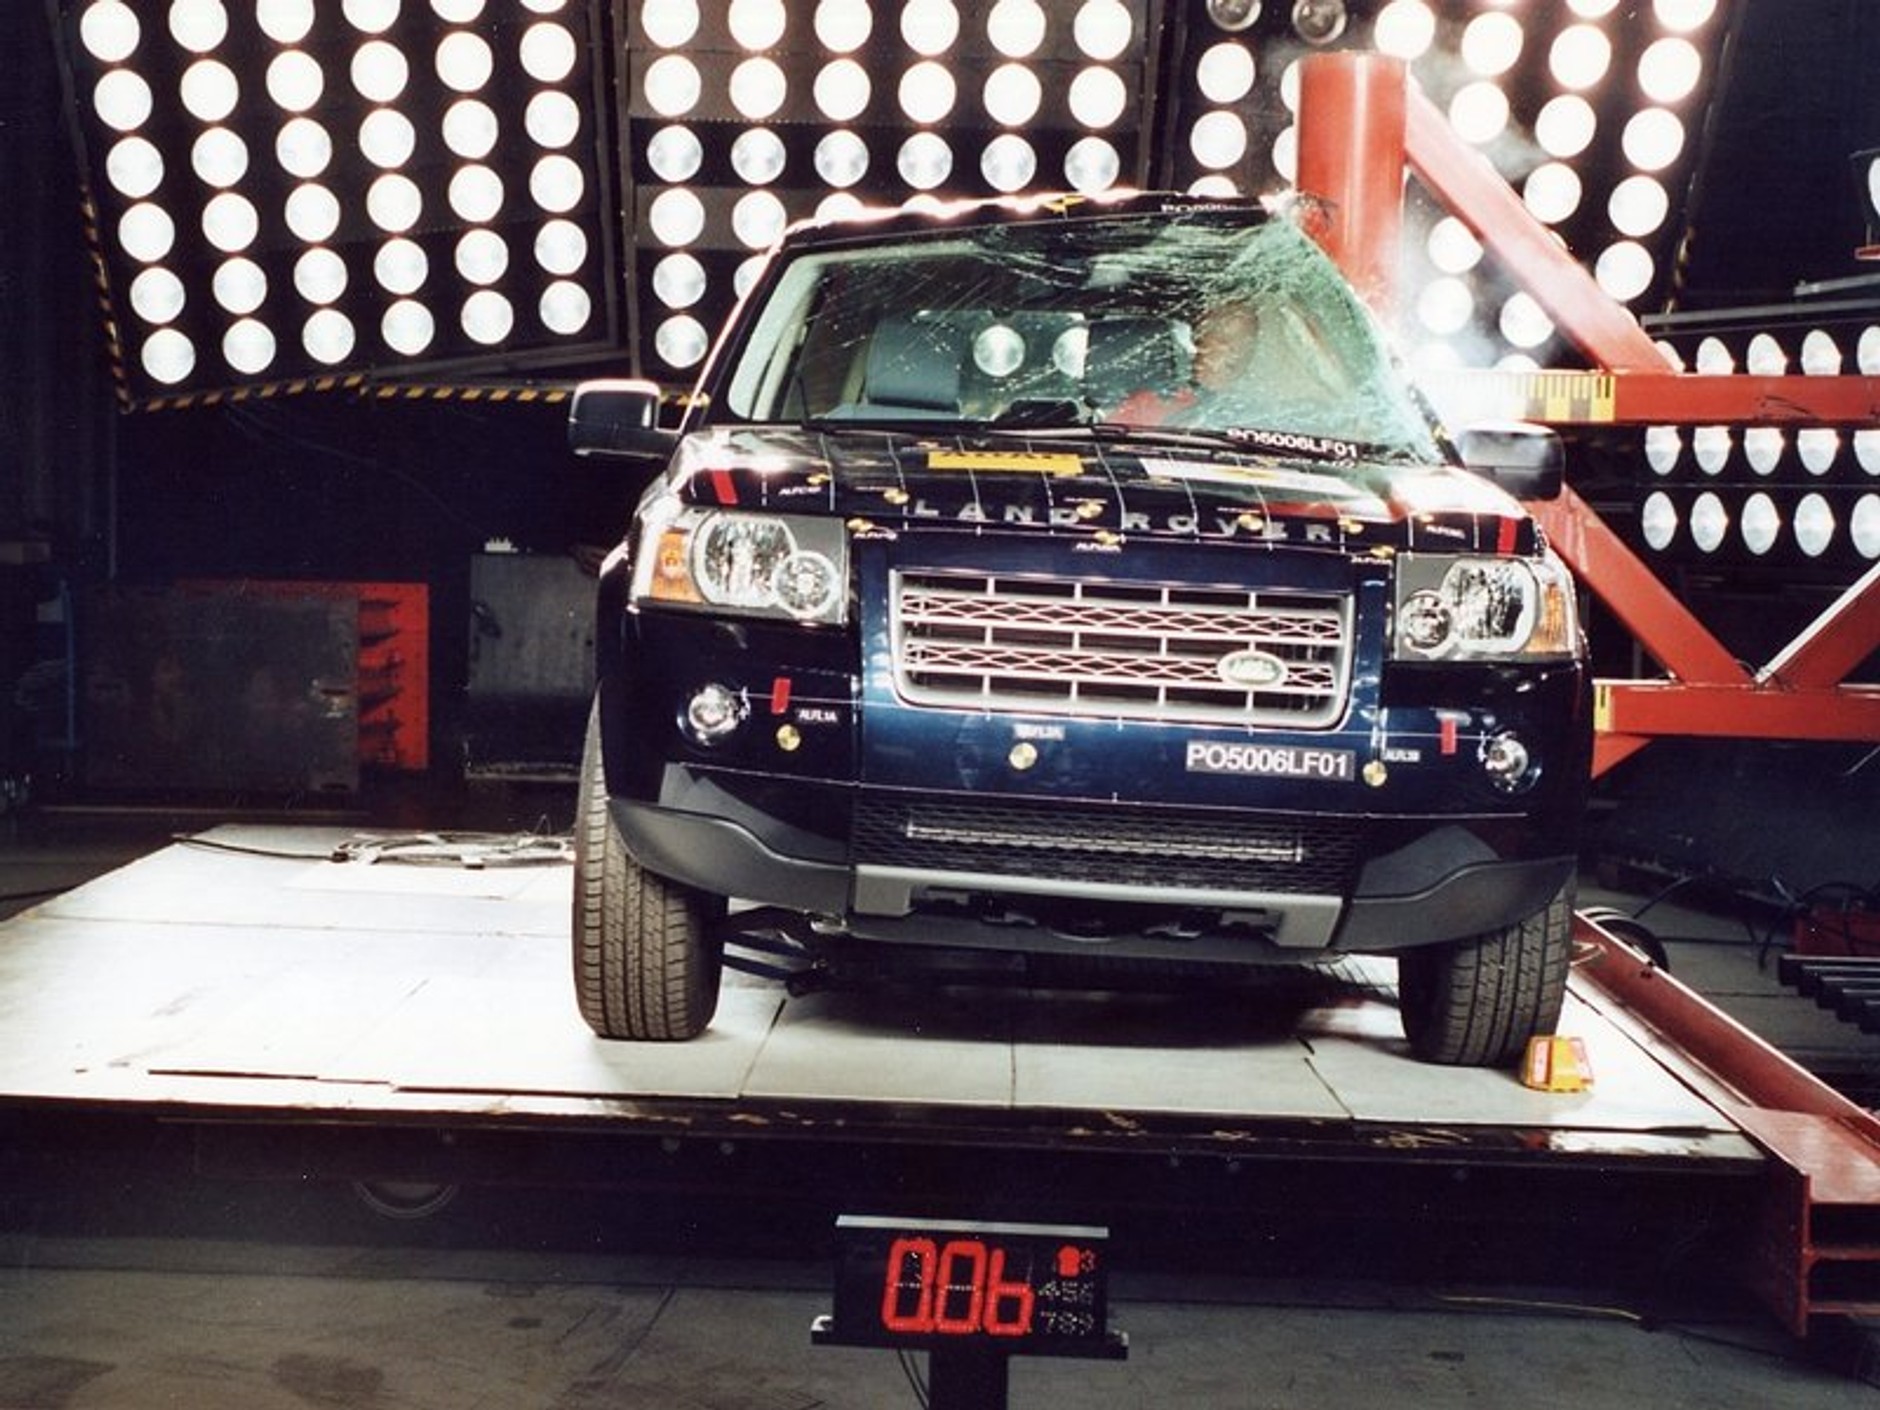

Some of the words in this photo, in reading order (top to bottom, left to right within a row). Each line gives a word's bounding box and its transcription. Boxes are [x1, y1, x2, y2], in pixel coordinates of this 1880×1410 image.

[914, 500, 1080, 525] LAND
[1122, 511, 1332, 543] ROVER
[1187, 743, 1348, 778] PO5006LF01
